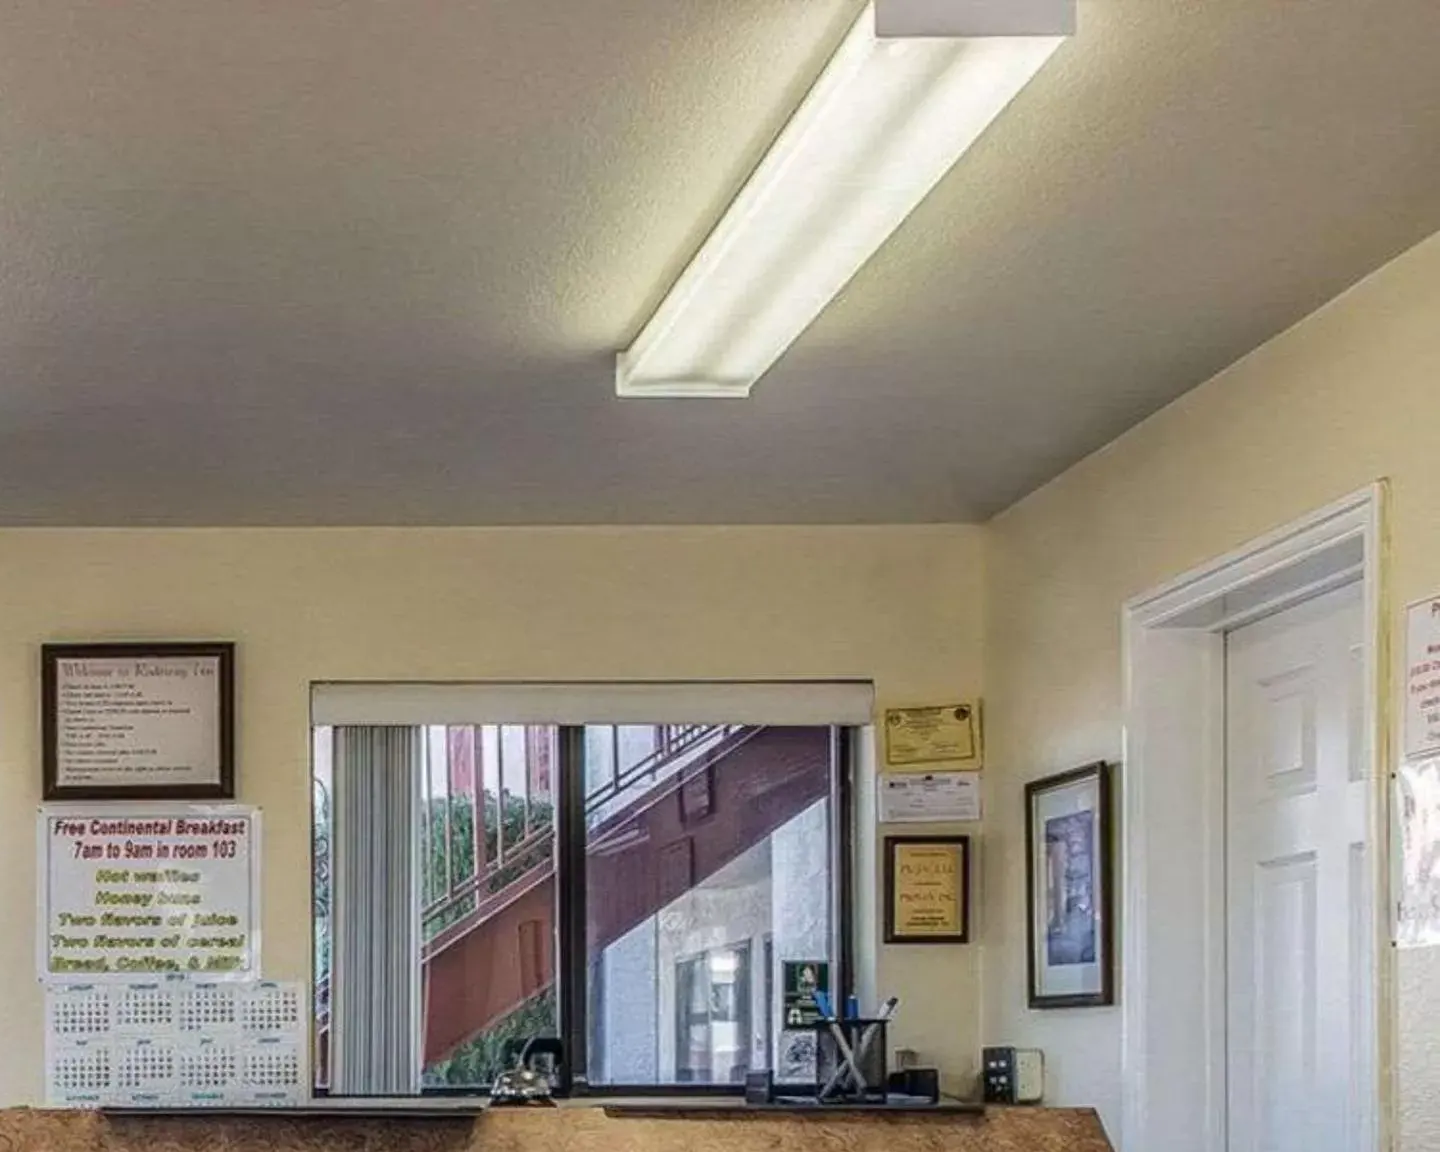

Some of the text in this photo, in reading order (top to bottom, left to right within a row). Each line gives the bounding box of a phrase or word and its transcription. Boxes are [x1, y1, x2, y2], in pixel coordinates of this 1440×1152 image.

[54, 819, 245, 836] Free Continental Breakfast
[74, 840, 237, 859] 7am to 9am in room 103
[58, 911, 97, 927] Two
[167, 912, 188, 927] of
[50, 933, 89, 948] Two
[160, 933, 181, 948] of
